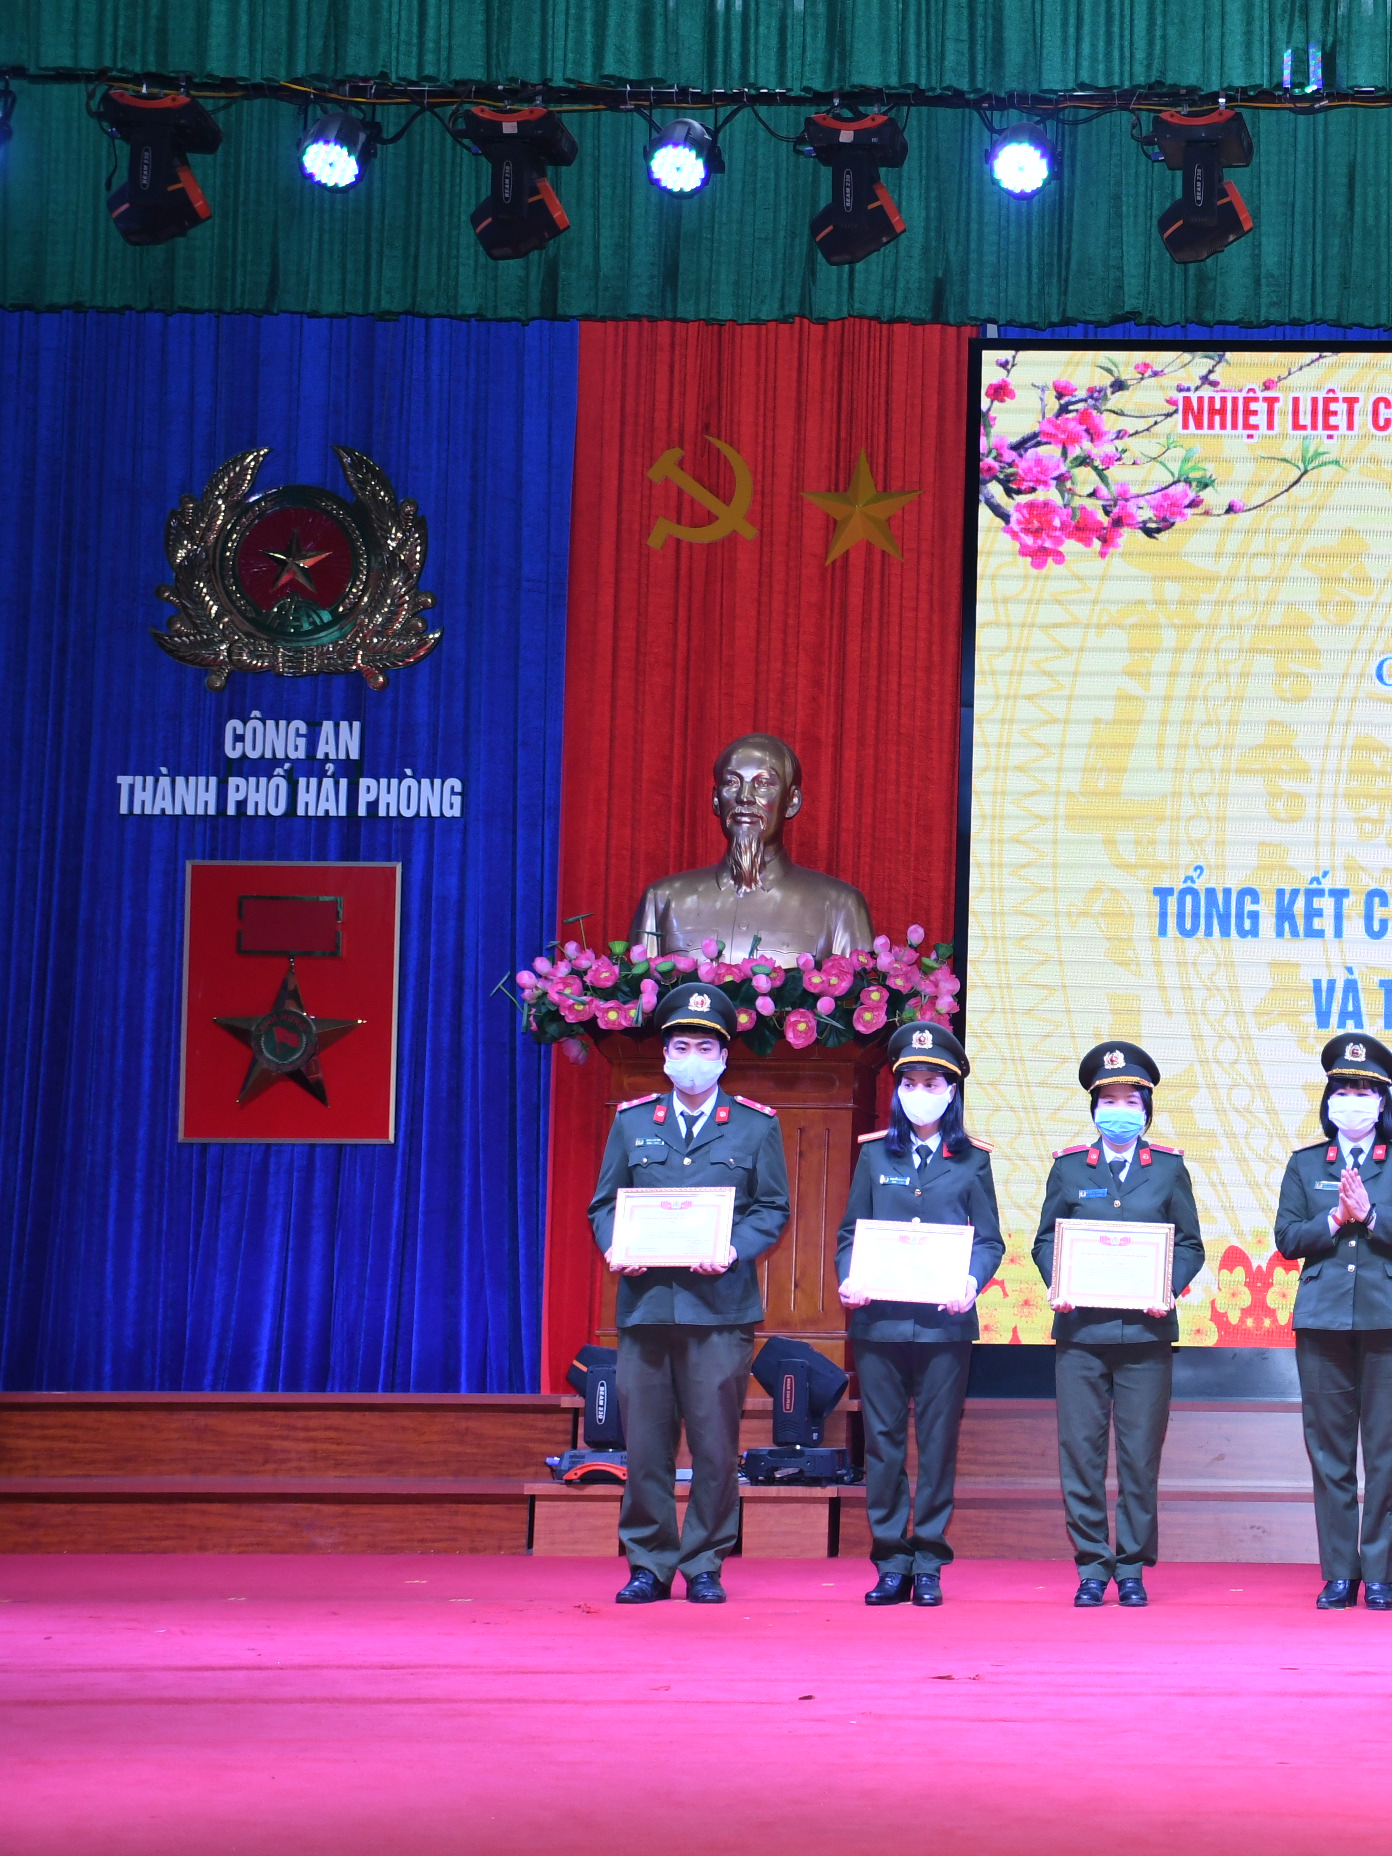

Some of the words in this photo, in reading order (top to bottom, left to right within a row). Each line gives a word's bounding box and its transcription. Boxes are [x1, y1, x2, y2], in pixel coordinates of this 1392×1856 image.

[1182, 388, 1280, 438] NHIỆT
[1292, 389, 1359, 439] LIỆT
[224, 710, 307, 759] CÔNG
[316, 720, 361, 759] AN
[116, 766, 218, 815] THÀNH
[226, 763, 292, 816] PHỐ
[296, 763, 348, 817] HẢI
[357, 768, 463, 818] PHÒNG
[1153, 864, 1260, 939] TỔNG
[1275, 870, 1350, 939] KẾT
[1312, 966, 1364, 1030] VÀ
